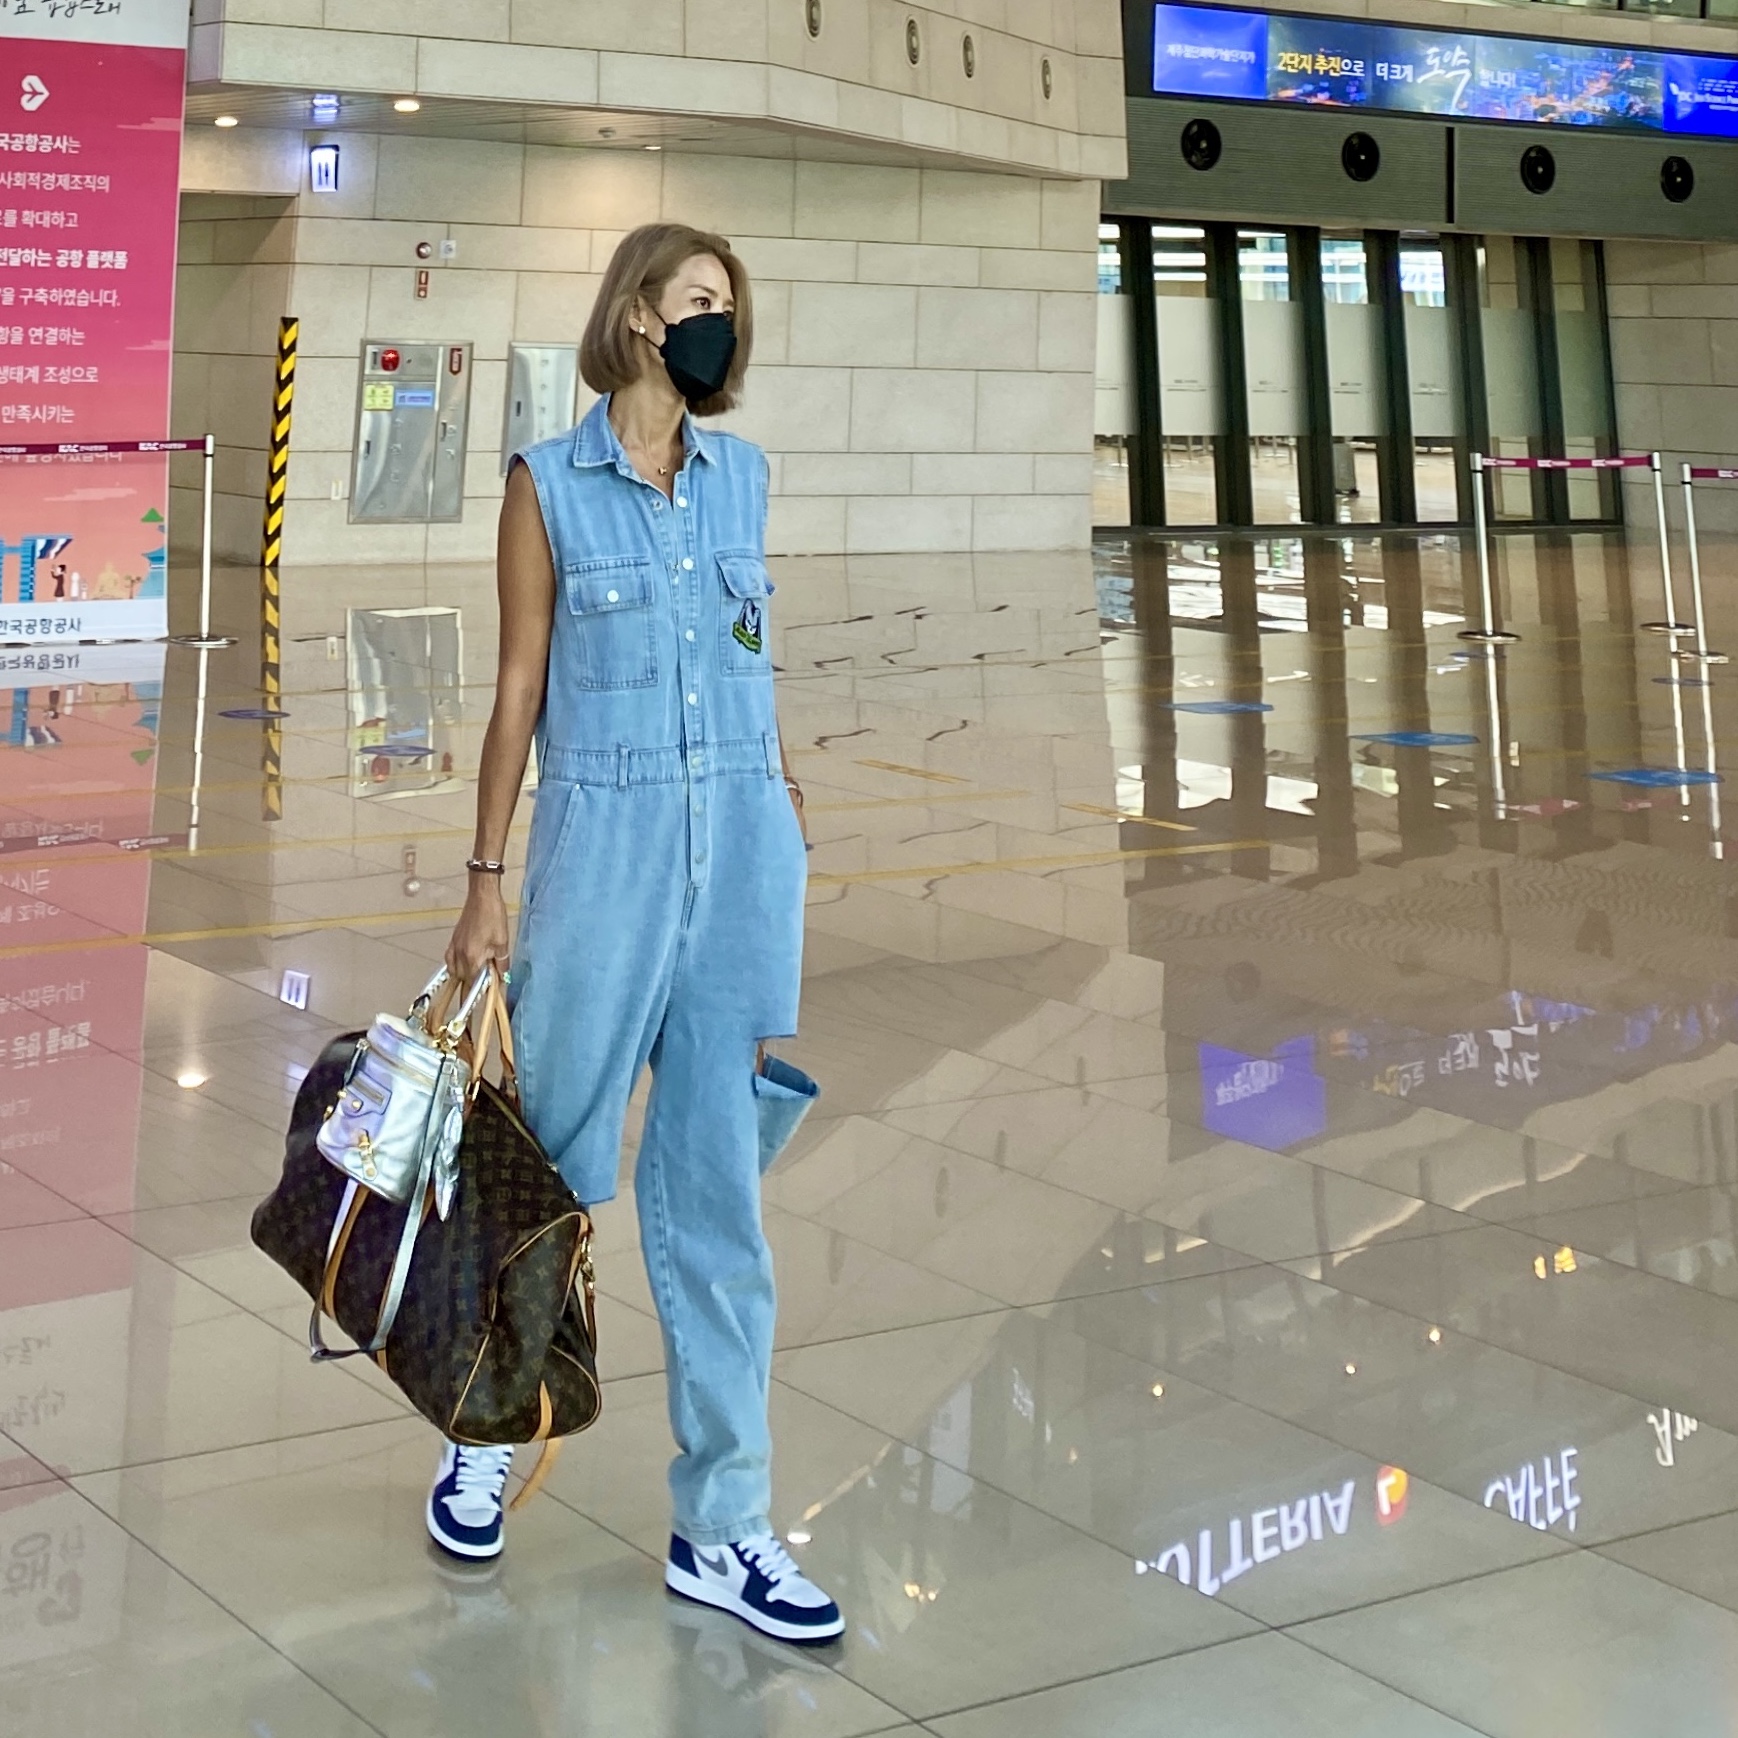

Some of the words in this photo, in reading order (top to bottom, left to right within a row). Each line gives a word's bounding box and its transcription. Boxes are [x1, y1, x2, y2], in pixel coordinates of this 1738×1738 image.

[1278, 52, 1312, 74] 2단지
[1314, 55, 1366, 77] 추진으로
[0, 171, 110, 193] 사회적경제조직의
[0, 209, 17, 228] 를
[21, 210, 79, 228] 확대하고
[56, 250, 83, 268] 공항
[86, 251, 128, 269] 플랫폼
[0, 287, 15, 306] 을
[19, 288, 121, 307] 구축하였습니다.
[28, 327, 86, 345] 연결하는
[43, 366, 99, 384] 조성으로
[1, 405, 75, 423] 만족시키는
